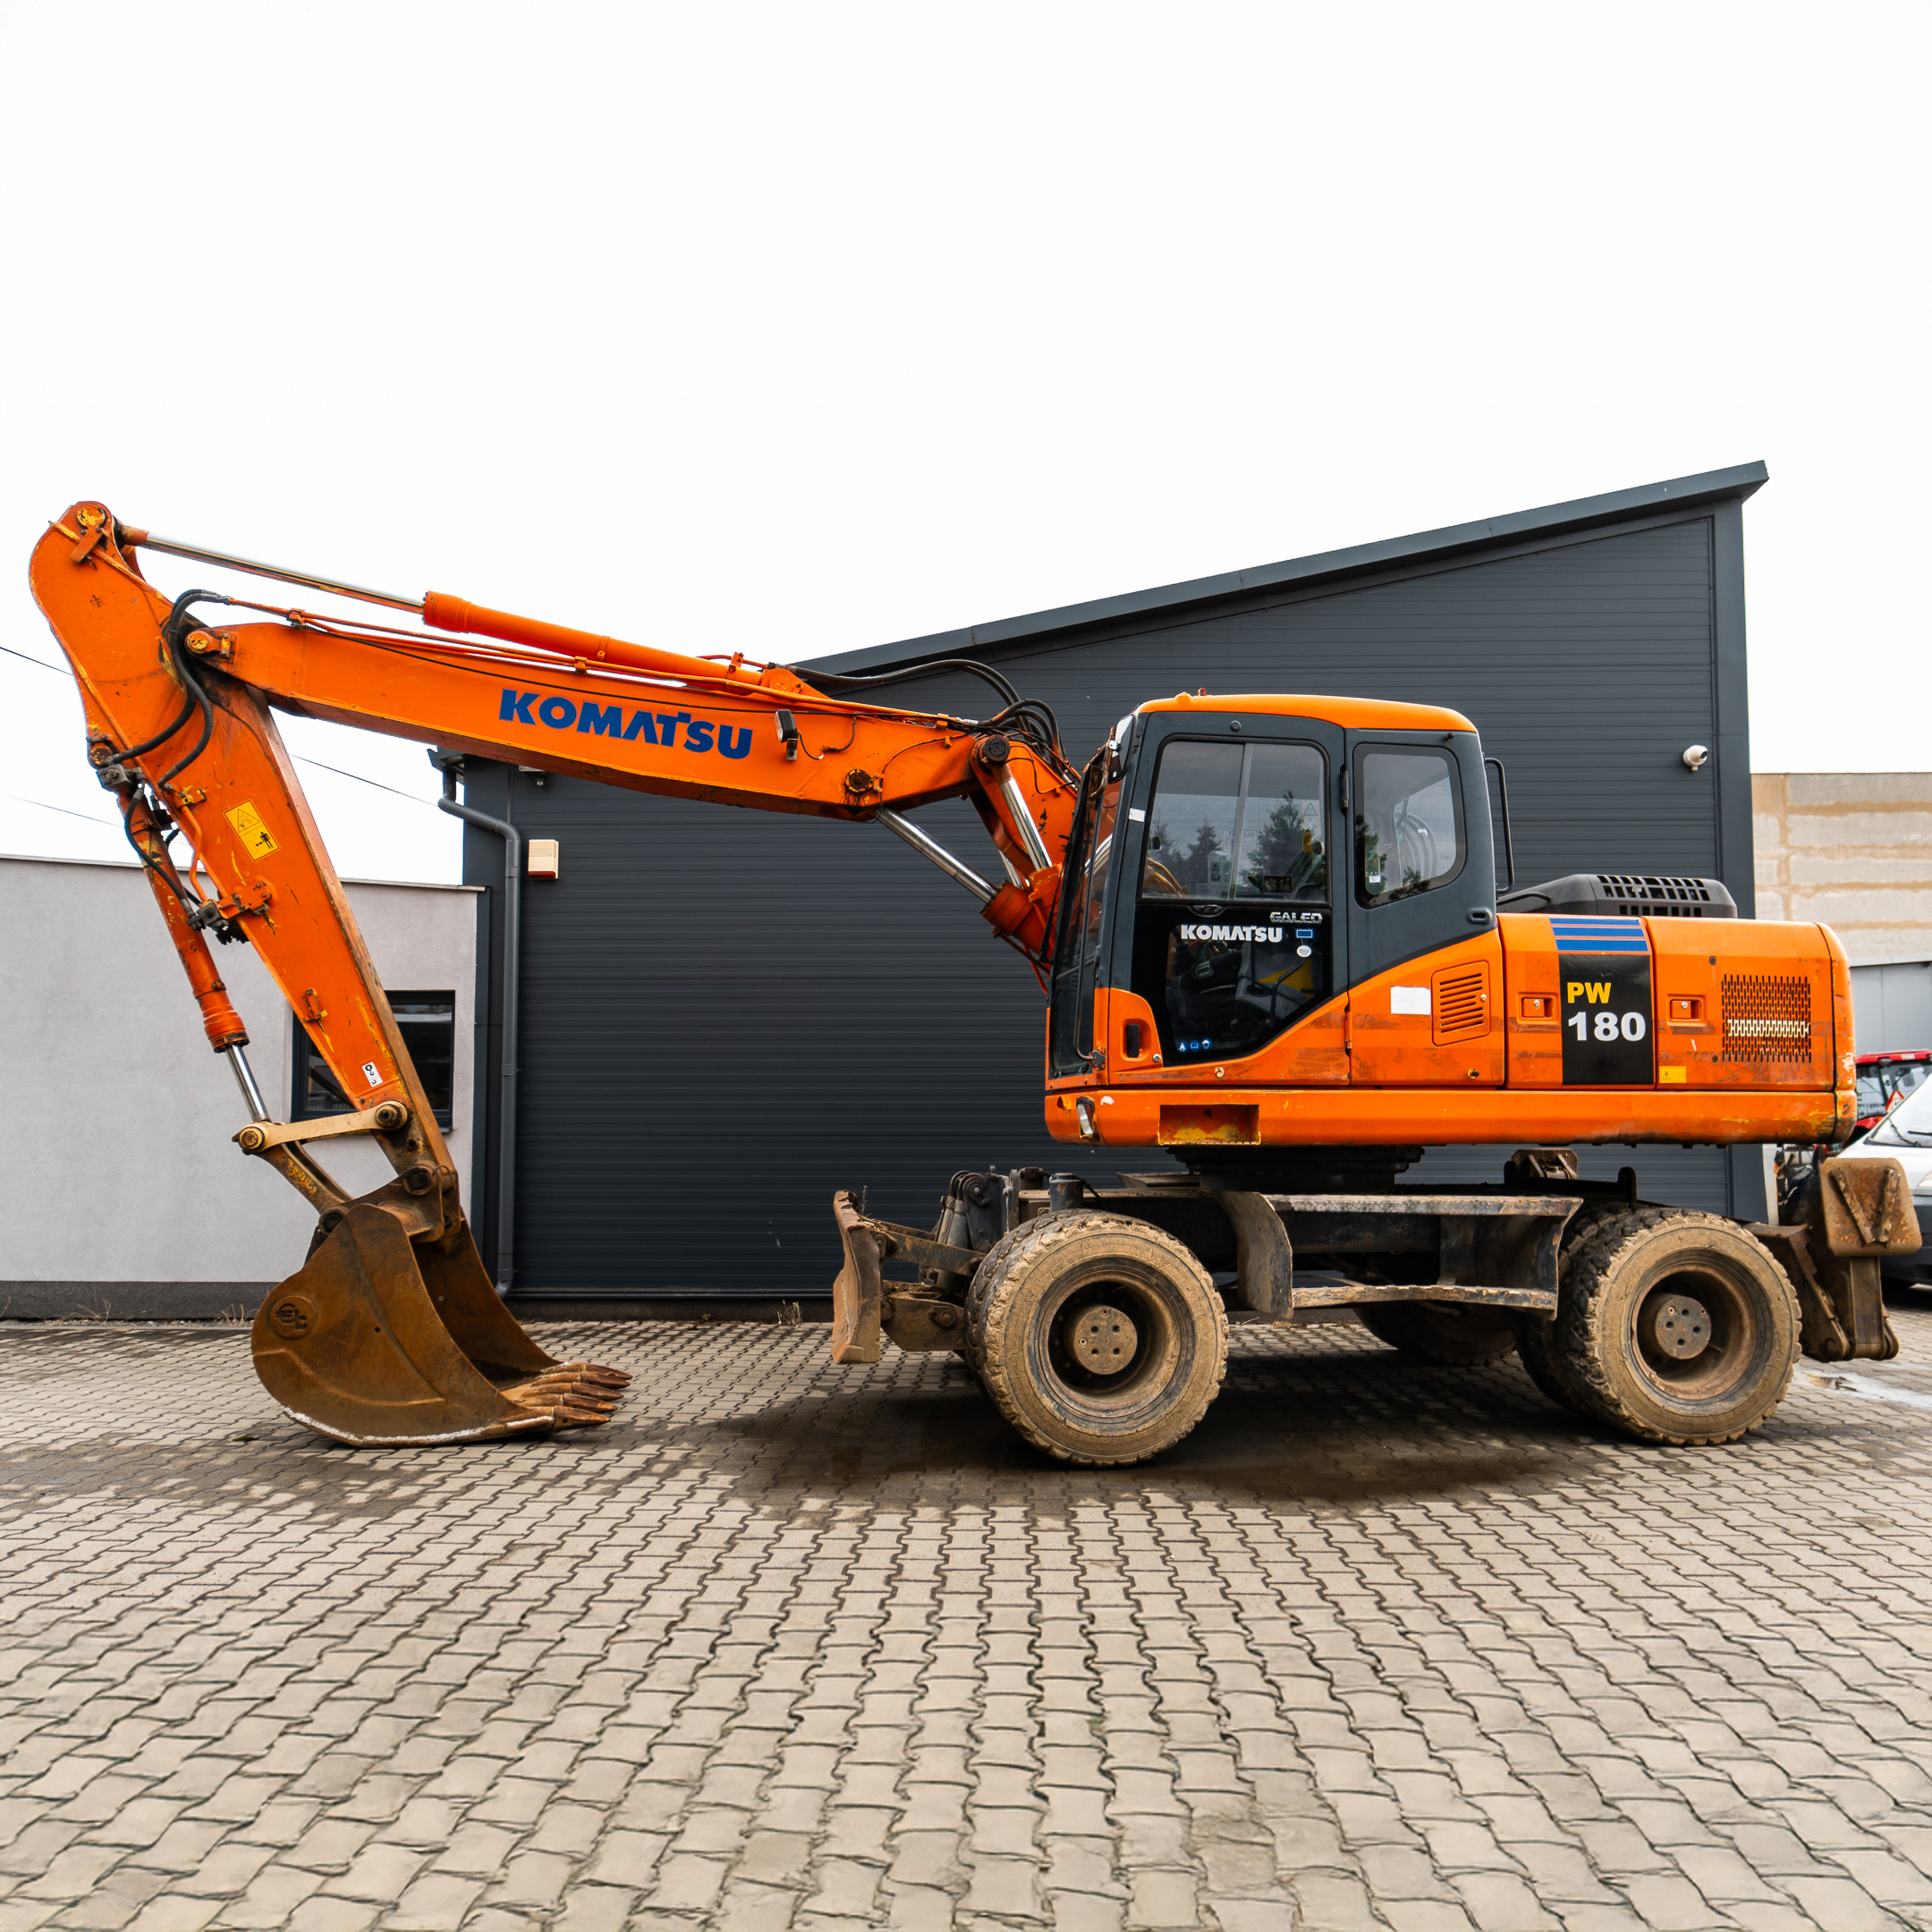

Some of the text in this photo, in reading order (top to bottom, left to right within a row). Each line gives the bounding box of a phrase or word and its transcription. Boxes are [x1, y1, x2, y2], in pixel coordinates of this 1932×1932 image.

[498, 688, 754, 759] KOMATSU
[1269, 911, 1323, 924] GALEO
[1181, 925, 1283, 943] KOMATSU
[1567, 982, 1612, 1004] PW
[1568, 1012, 1646, 1041] 180
